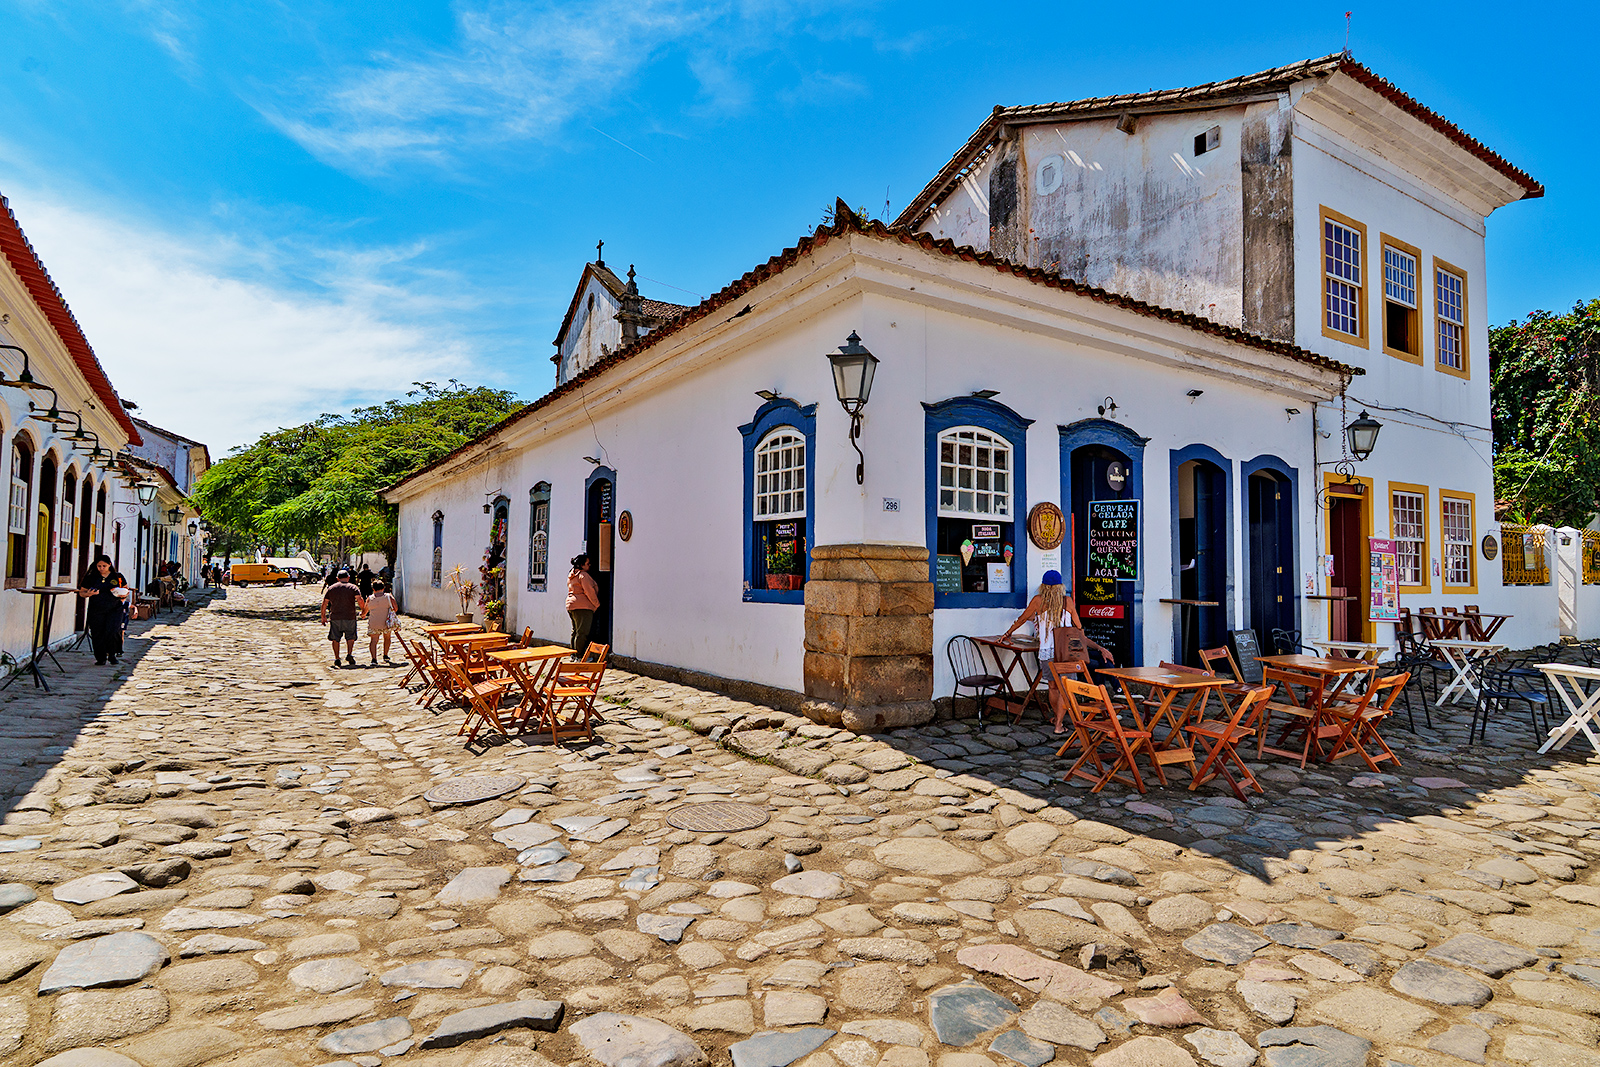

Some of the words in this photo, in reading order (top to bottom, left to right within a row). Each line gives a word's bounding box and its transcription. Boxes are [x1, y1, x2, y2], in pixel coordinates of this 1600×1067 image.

[885, 501, 898, 511] 296
[1093, 504, 1135, 513] CERVEJA
[1098, 511, 1134, 519] GELADA
[1090, 529, 1137, 538] CAPUCCINO
[1090, 538, 1138, 547] CHOCOLATE
[1096, 546, 1132, 554] QUENTE
